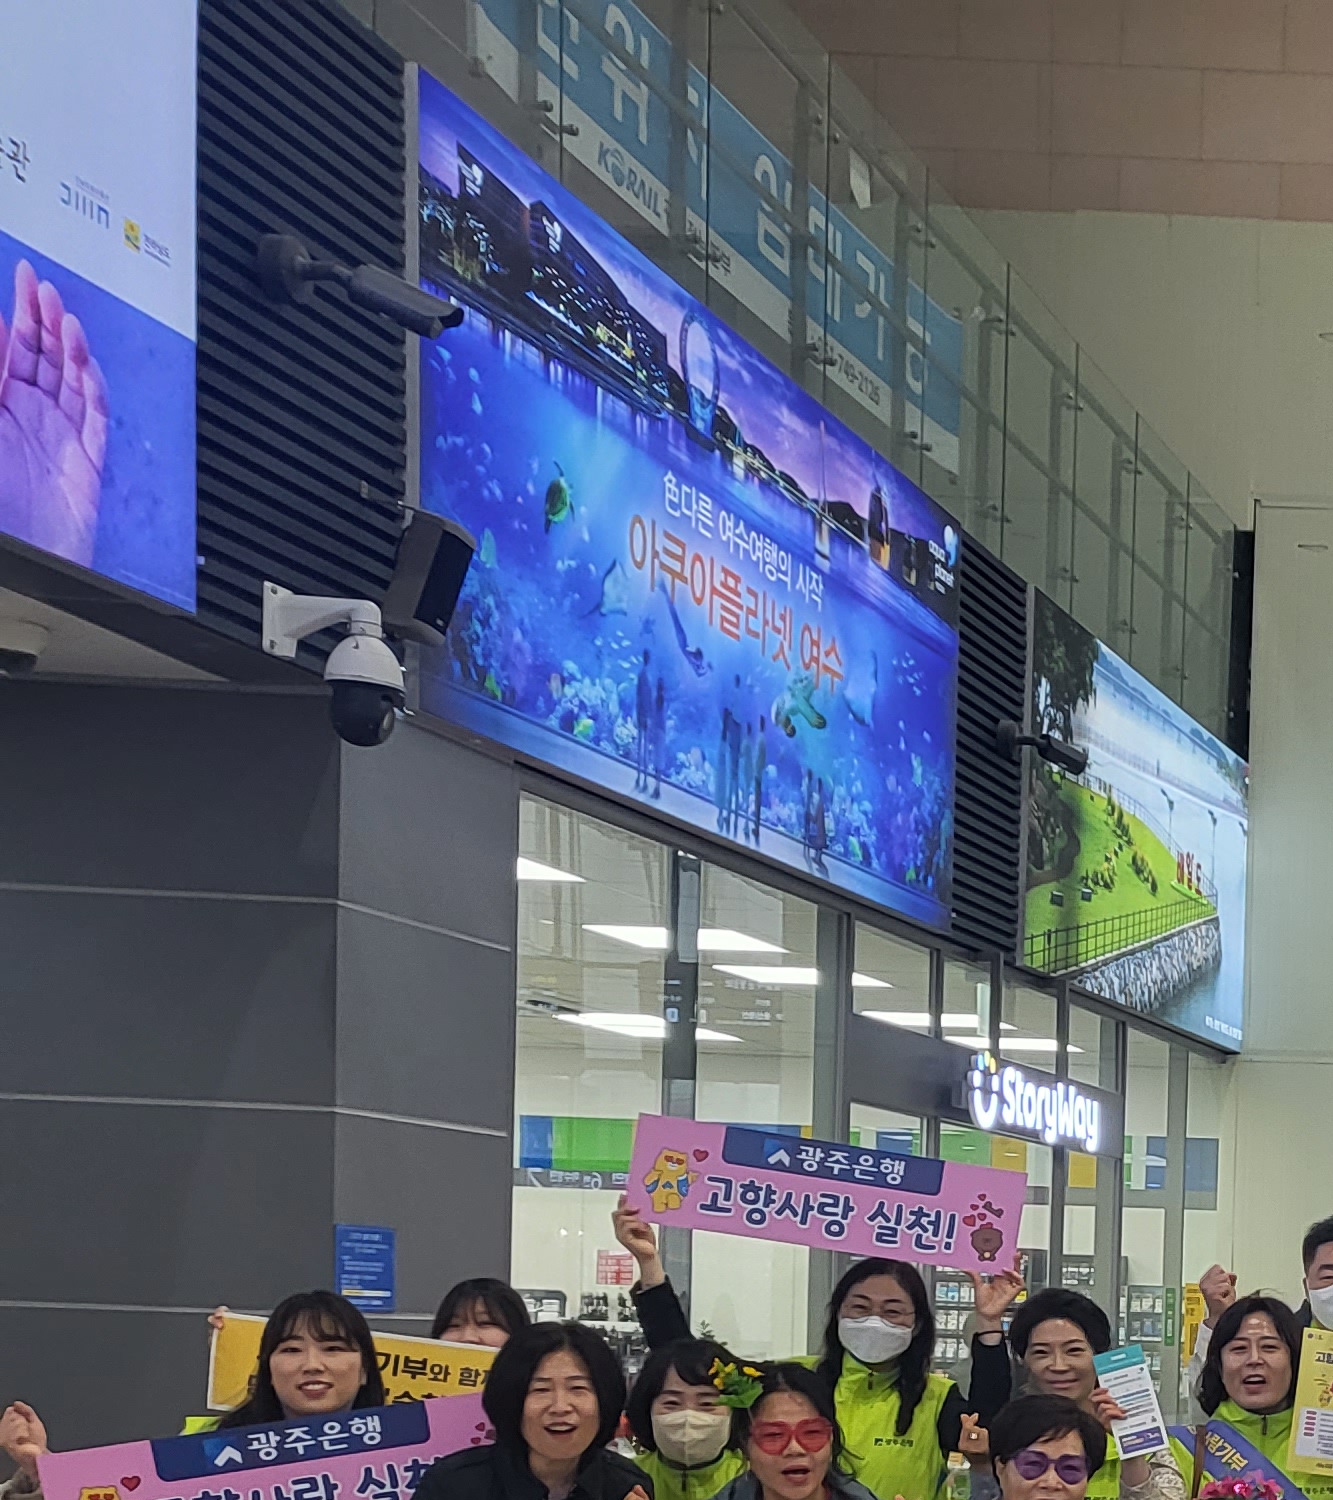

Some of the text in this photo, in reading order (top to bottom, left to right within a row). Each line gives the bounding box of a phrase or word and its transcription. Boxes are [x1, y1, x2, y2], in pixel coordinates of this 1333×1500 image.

[598, 140, 664, 218] KORAIL
[663, 469, 824, 612] 色다른 여수여행의 시작
[629, 514, 844, 692] 아쿠아플라넷 여수
[1001, 1066, 1099, 1152] StoryWay
[795, 1143, 907, 1185] 광주은행
[699, 1174, 958, 1252] 고향사랑 실천!
[247, 1415, 382, 1461] 광주은행
[1206, 1431, 1249, 1472] 랑기부
